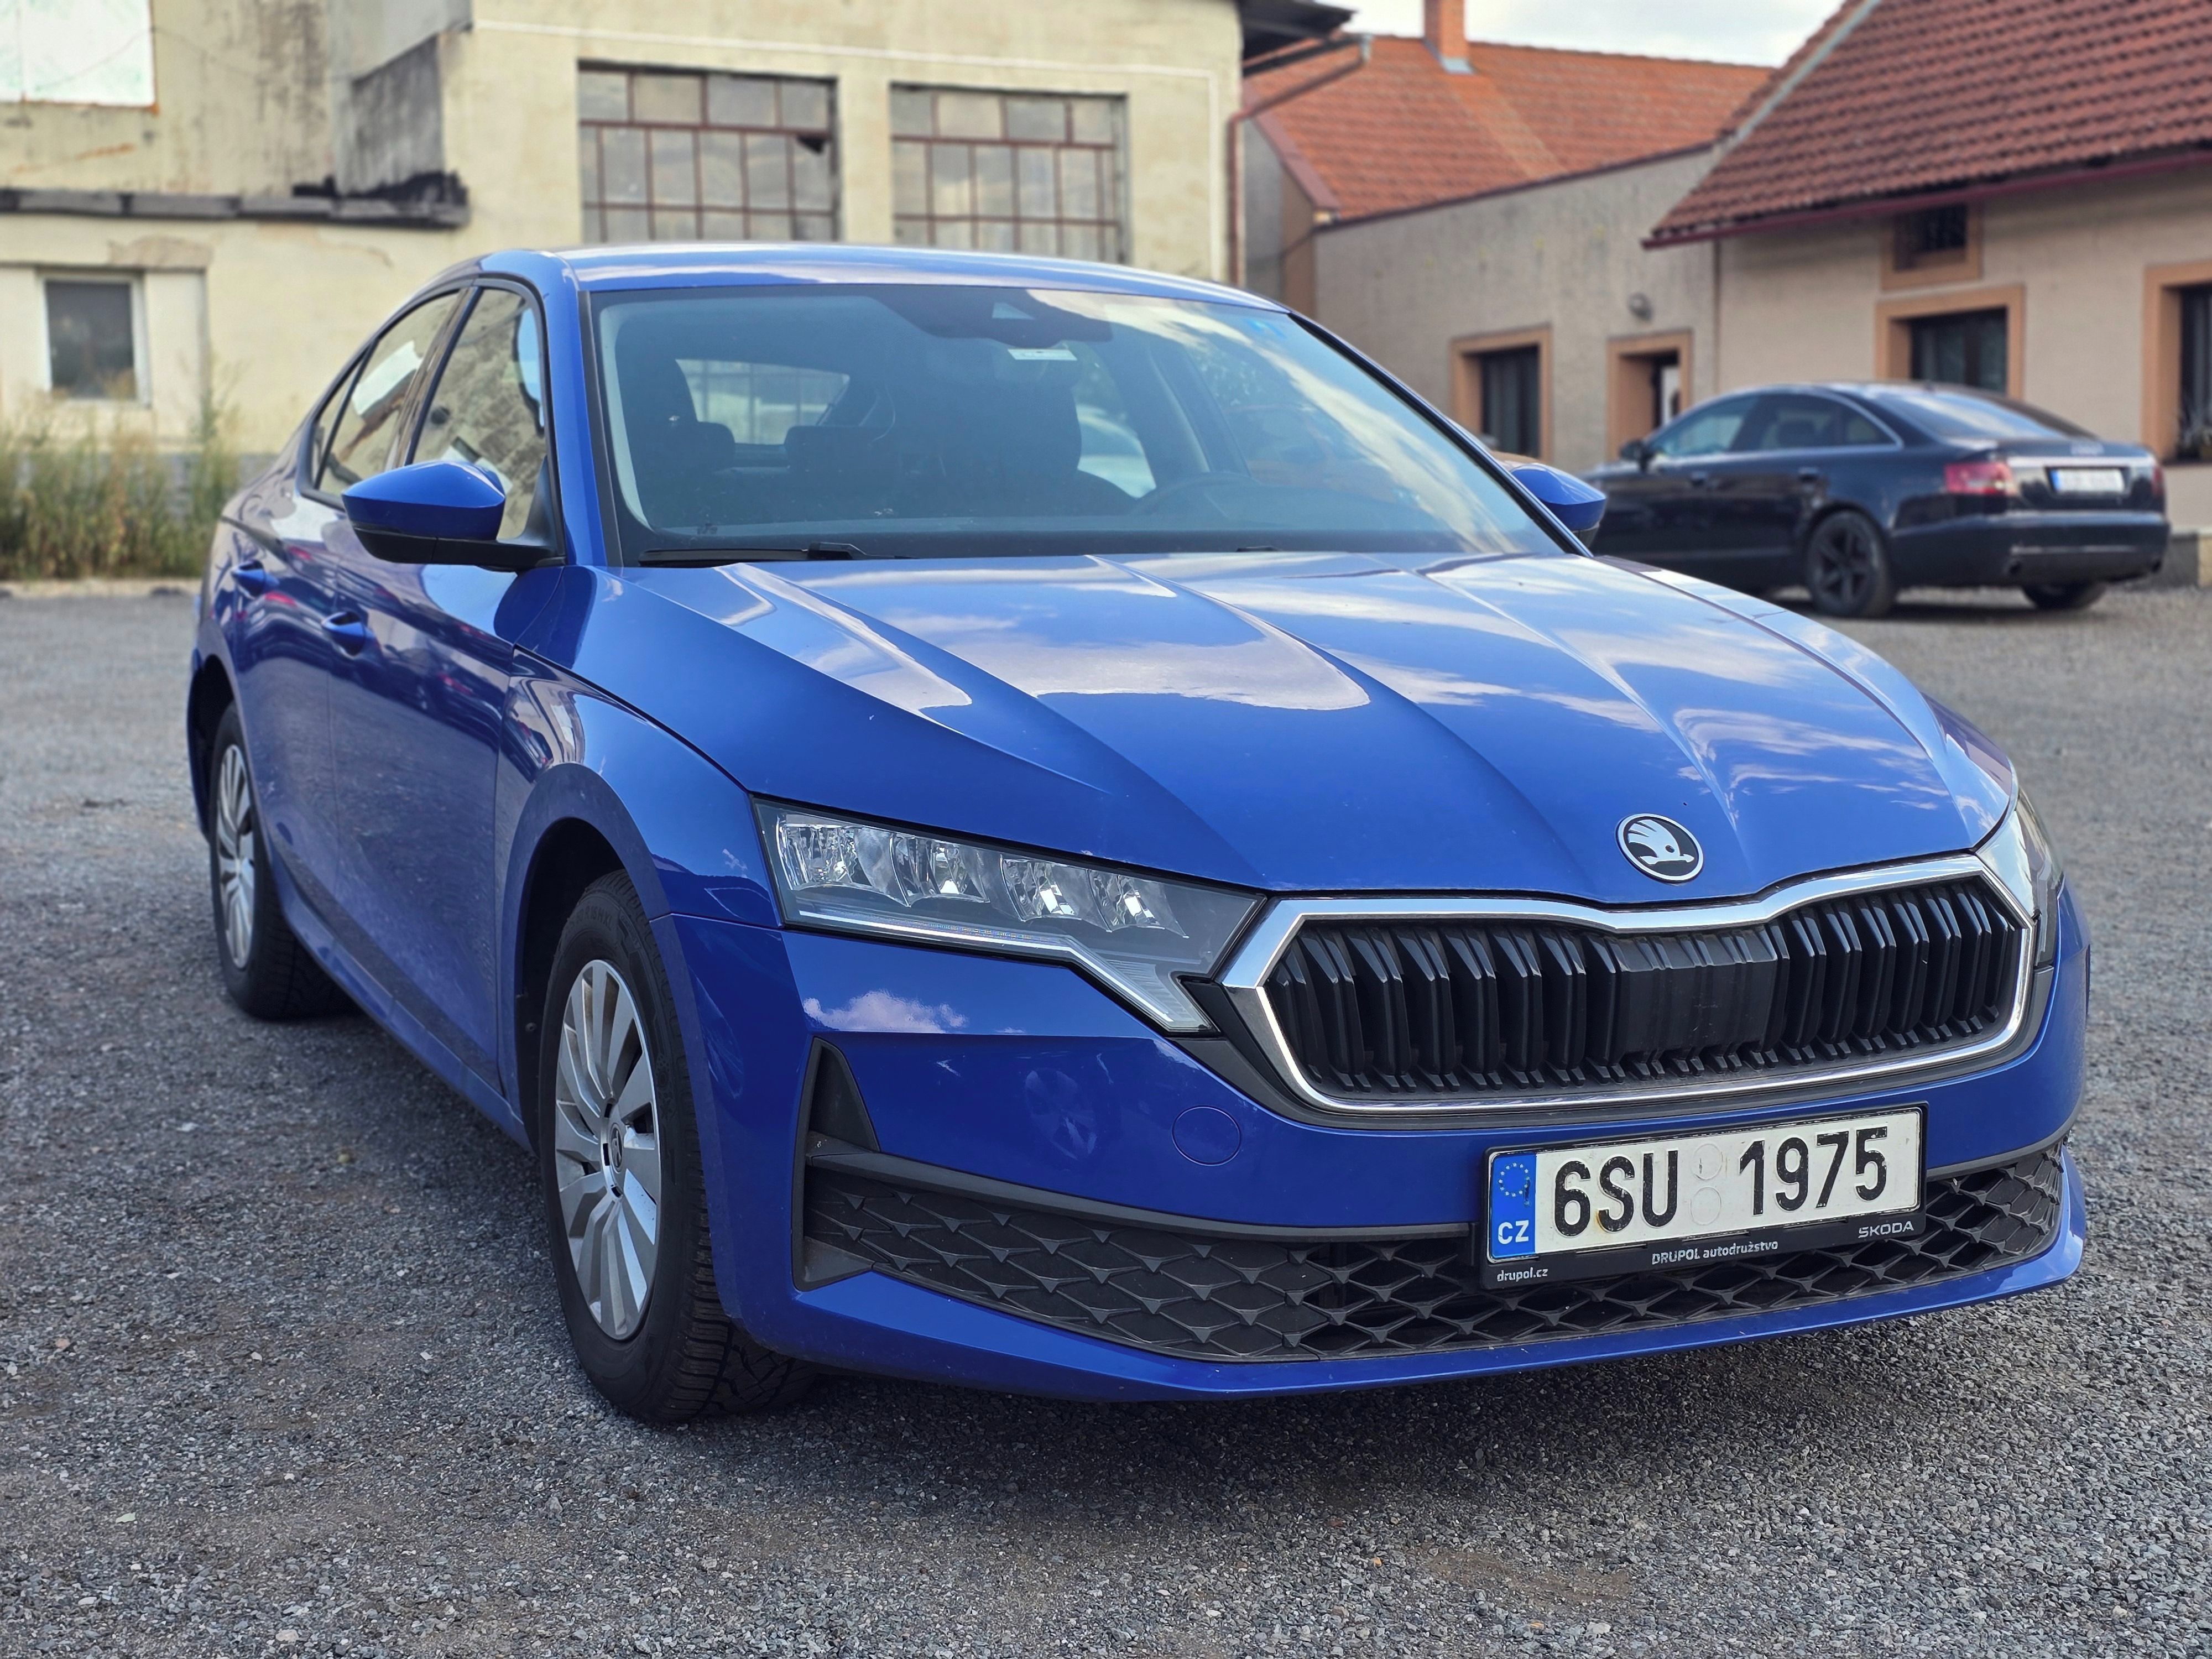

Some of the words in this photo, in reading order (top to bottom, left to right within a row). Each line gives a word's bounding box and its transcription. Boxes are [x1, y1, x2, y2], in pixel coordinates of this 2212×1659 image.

[1554, 1150, 1678, 1237] 6SU
[1739, 1126, 1888, 1215] 1975
[1498, 1219, 1530, 1244] CZ
[1651, 1247, 1700, 1265] DRUPOL
[1703, 1241, 1779, 1259] autodružstvo
[1496, 1267, 1548, 1282] drupol.cz
